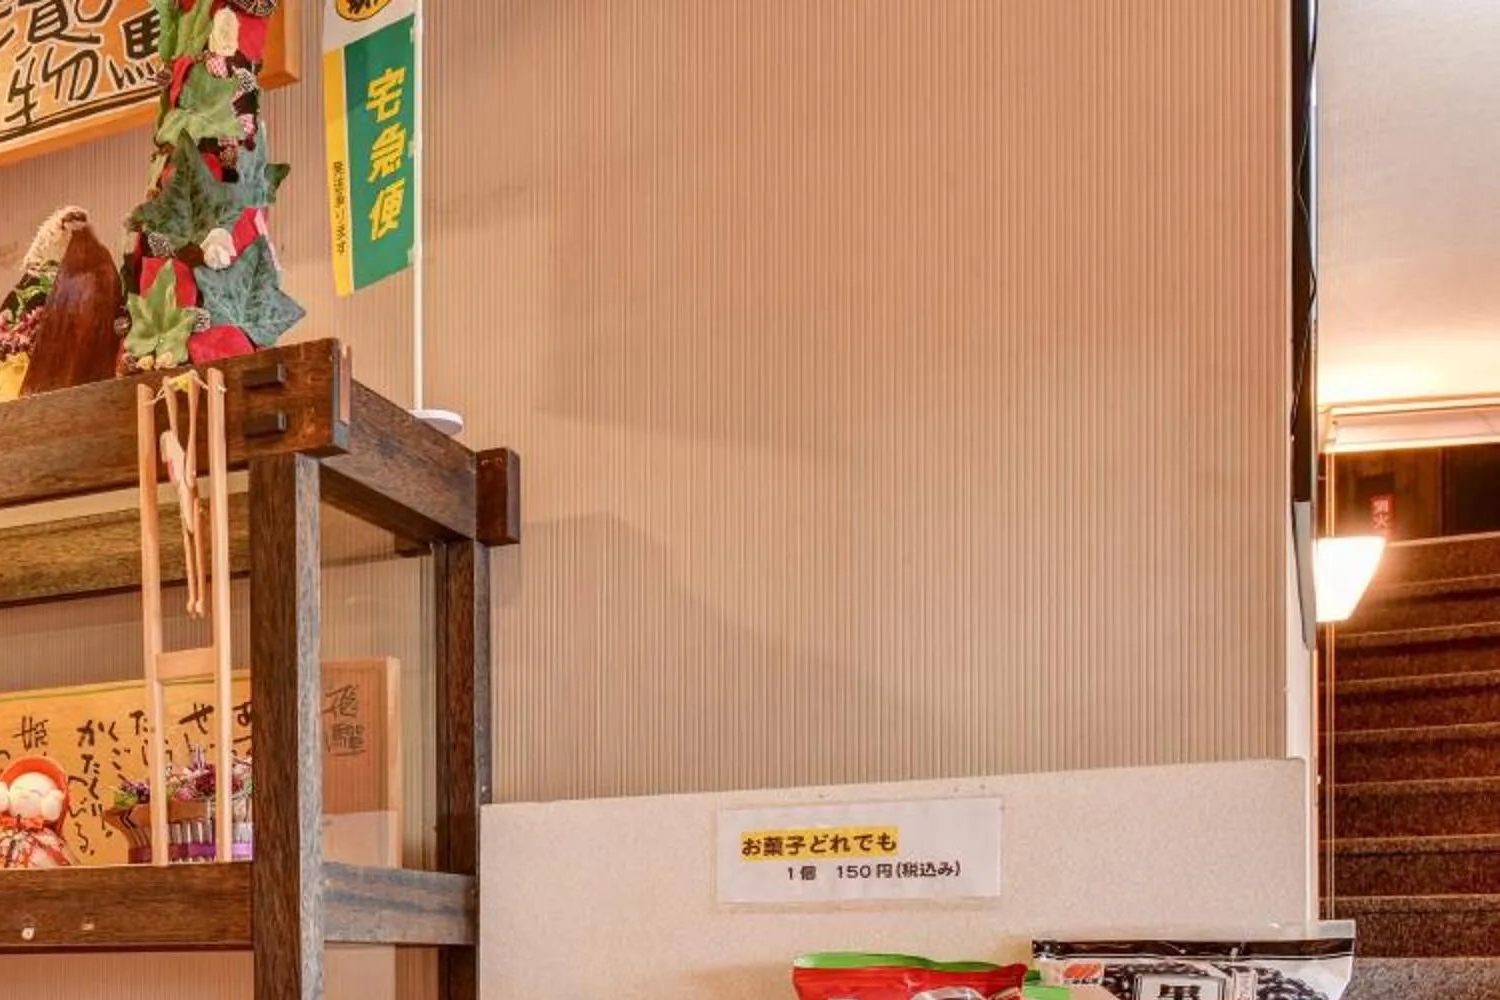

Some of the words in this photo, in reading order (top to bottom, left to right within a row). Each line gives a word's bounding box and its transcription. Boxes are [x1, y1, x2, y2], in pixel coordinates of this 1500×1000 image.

[365, 66, 407, 242] 宅急便
[741, 832, 897, 857] お菓子どれでも
[787, 864, 817, 881] 1個
